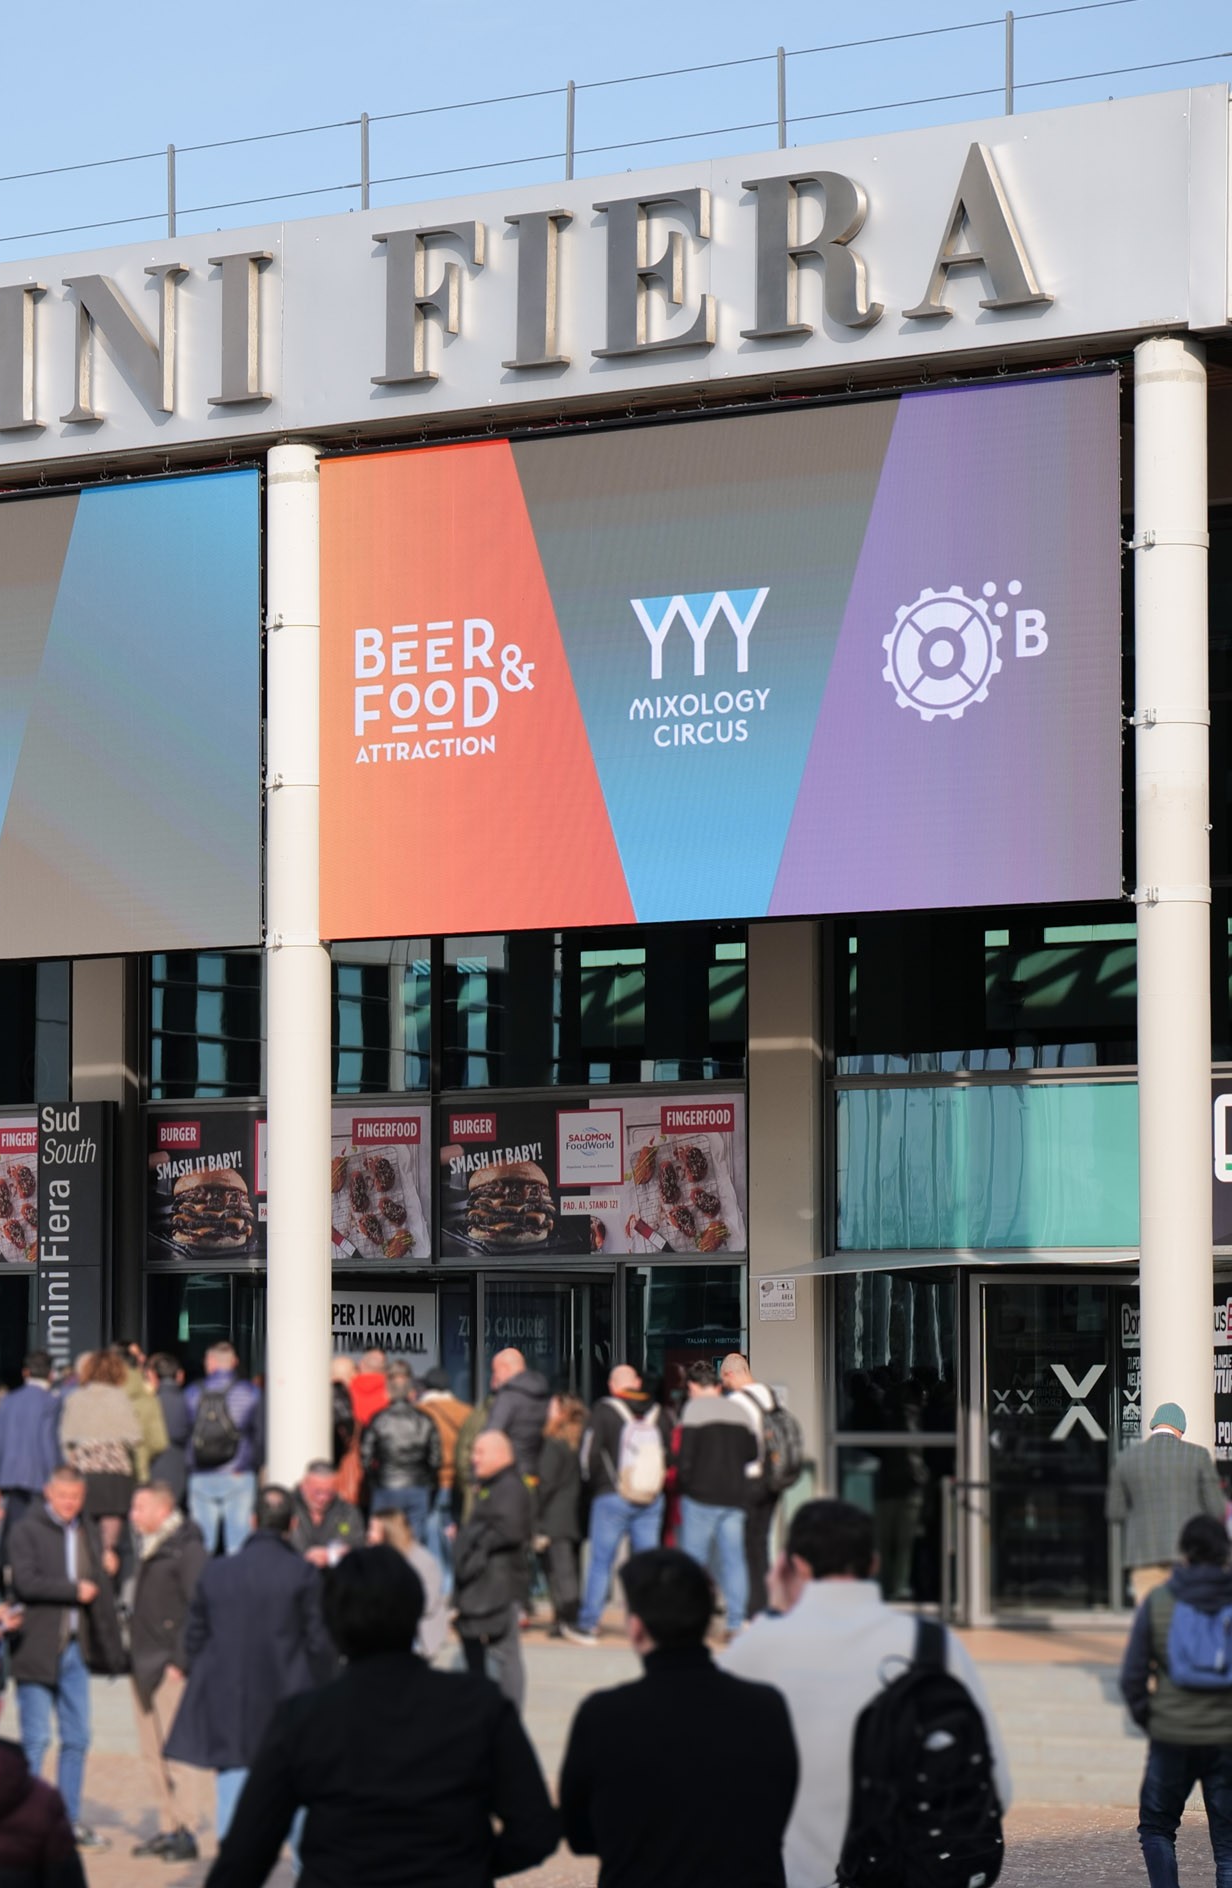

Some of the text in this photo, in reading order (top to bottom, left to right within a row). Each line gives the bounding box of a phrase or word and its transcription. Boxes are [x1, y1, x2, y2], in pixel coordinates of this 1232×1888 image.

[371, 142, 1054, 386] FIERA
[1015, 609, 1049, 658] B
[354, 618, 535, 693] BEER &
[354, 676, 499, 737] FOOD
[628, 687, 771, 721] MIXOLOGY
[653, 718, 749, 748] CIRCUS
[355, 734, 496, 764] ATTRACTION
[41, 1106, 80, 1133] Sud
[358, 1121, 418, 1140] FINGERFOOD
[453, 1119, 493, 1134] BURGER
[666, 1109, 731, 1126] FINGERFOOD
[1, 1131, 37, 1147] FINGERF
[160, 1127, 196, 1142] BURGER
[566, 1140, 614, 1151] FoodWorld
[568, 1132, 612, 1142] SALOMON
[42, 1137, 97, 1165] South
[156, 1150, 242, 1180] SMASH IT BABY!
[449, 1142, 543, 1175] SMASH IT BABY!
[563, 1202, 577, 1210] PAD.
[589, 1200, 608, 1210] STAND
[609, 1200, 618, 1209] 121
[41, 1179, 70, 1262] Fiera
[331, 1304, 356, 1326] PER
[368, 1304, 415, 1327] LAVORI
